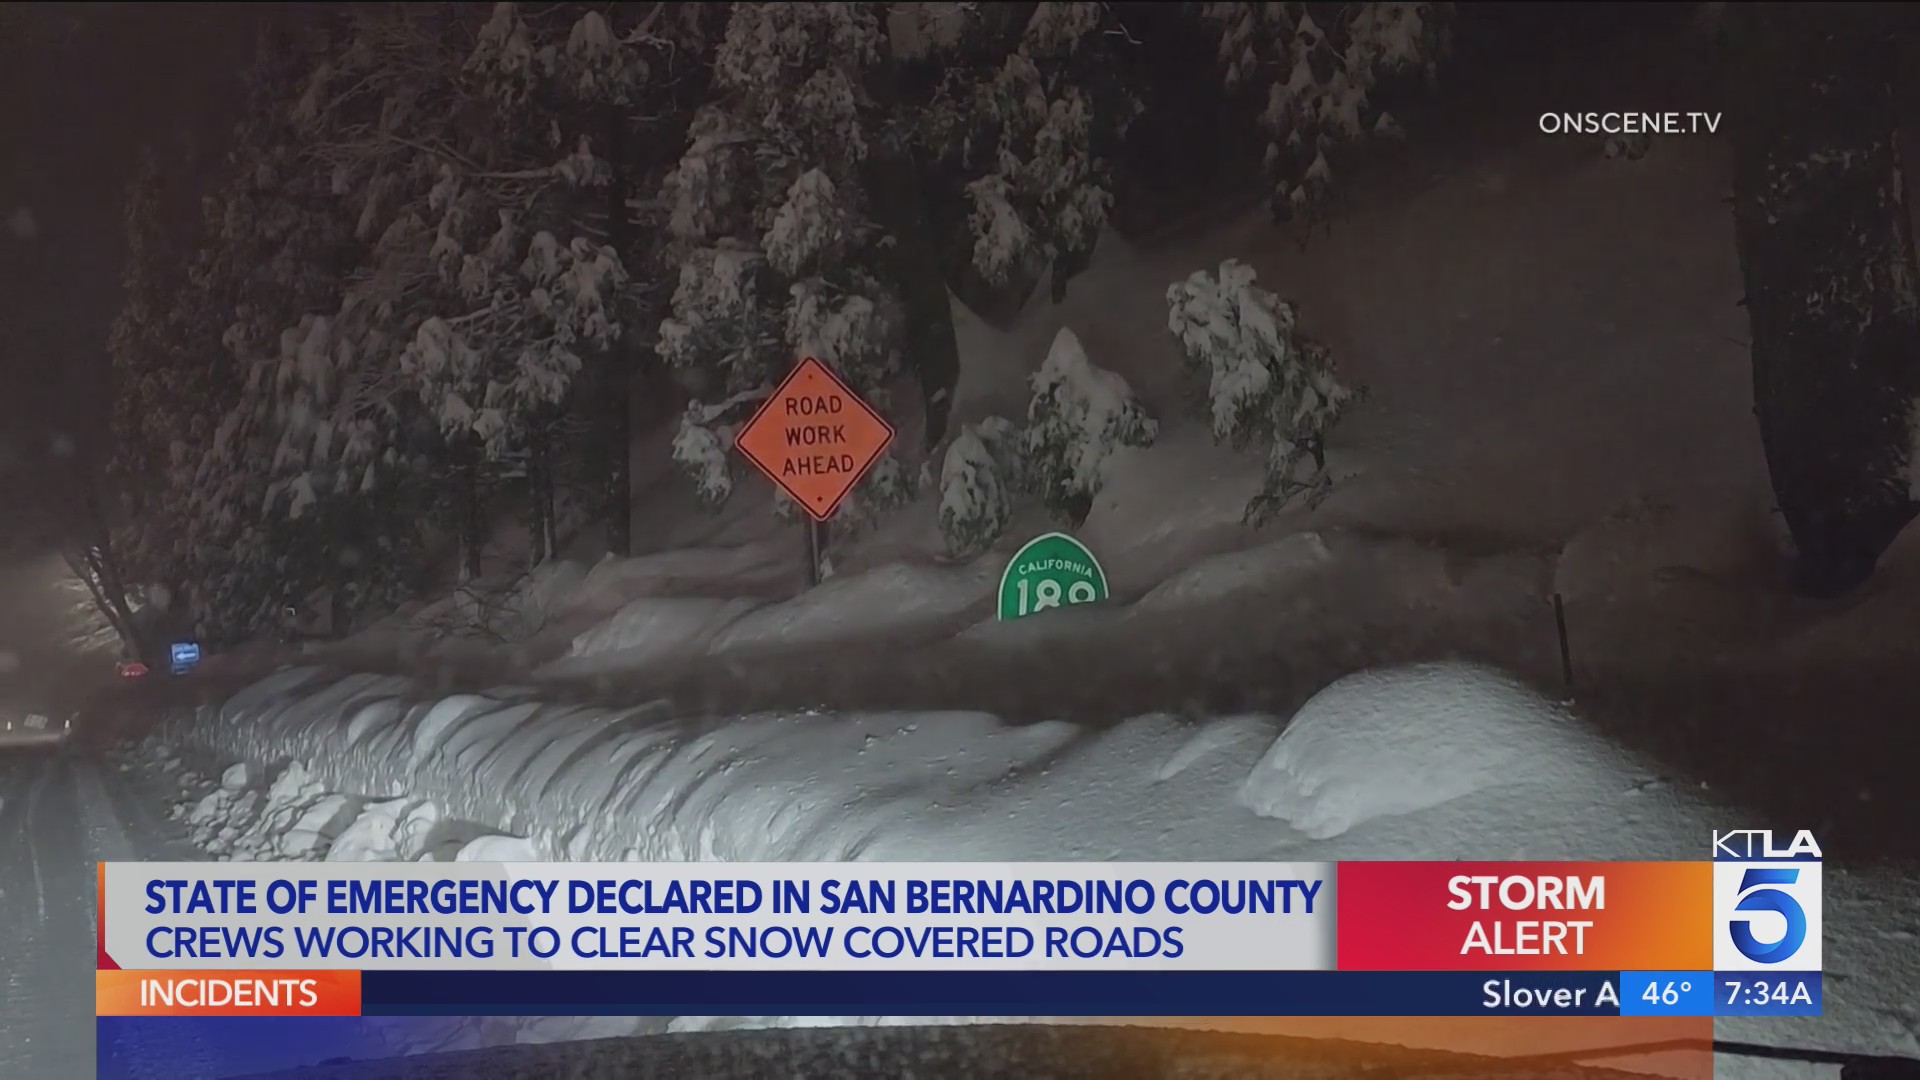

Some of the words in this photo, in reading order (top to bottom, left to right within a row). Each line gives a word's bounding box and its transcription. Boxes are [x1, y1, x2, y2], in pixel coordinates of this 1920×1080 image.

[785, 396, 842, 416] ROAD
[785, 425, 846, 446] WORK
[783, 455, 854, 476] AHEAD
[1018, 559, 1093, 578] CALIFORNIA
